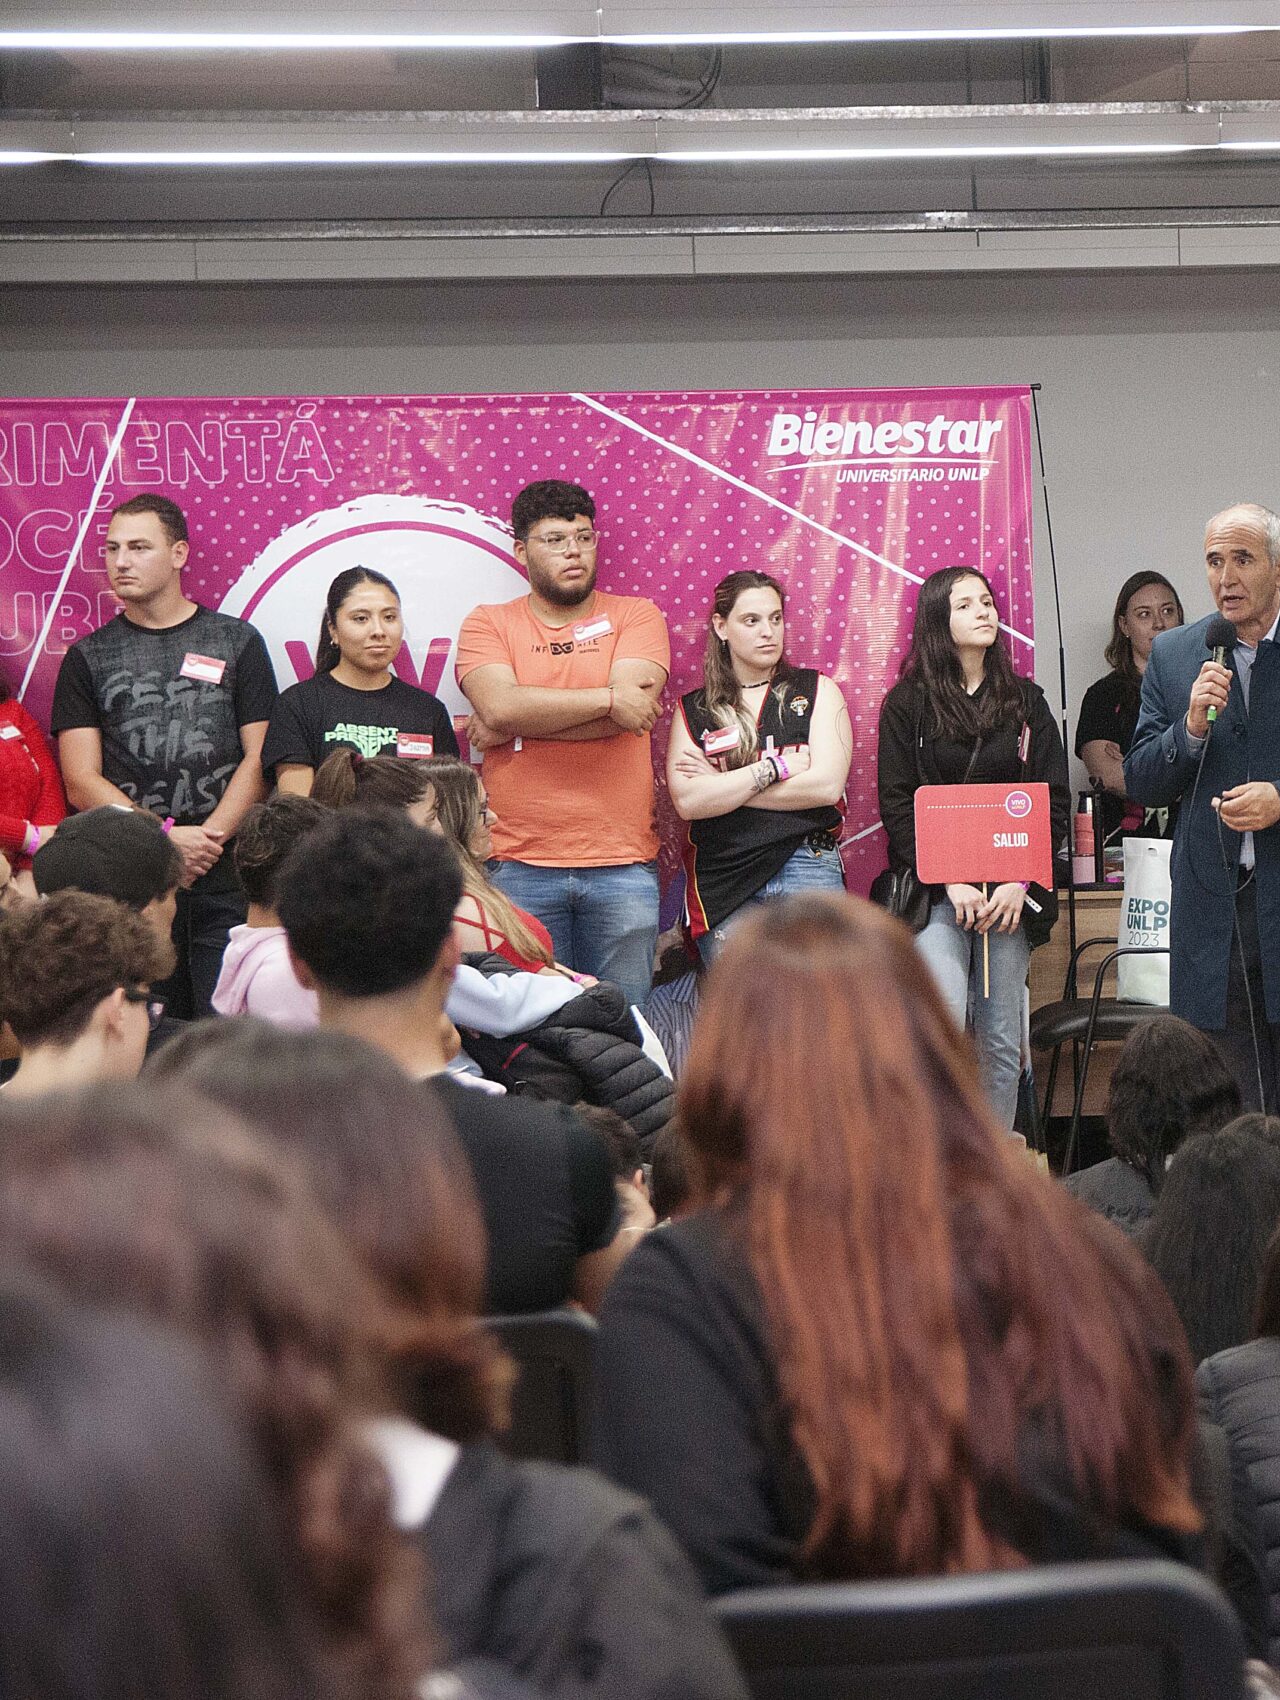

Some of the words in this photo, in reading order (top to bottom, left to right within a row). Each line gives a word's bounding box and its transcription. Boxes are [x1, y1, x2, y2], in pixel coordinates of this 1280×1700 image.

[767, 411, 1003, 456] Bienestar
[836, 468, 944, 483] UNIVERSITARIO
[949, 467, 990, 481] UNLP
[334, 723, 399, 736] ABSENT
[121, 717, 214, 770] THE
[325, 731, 398, 758] PRESENC
[993, 832, 1029, 848] SALUD
[1128, 897, 1170, 916] EXPO
[1127, 913, 1168, 931] UNLP
[1128, 930, 1160, 946] 2023
